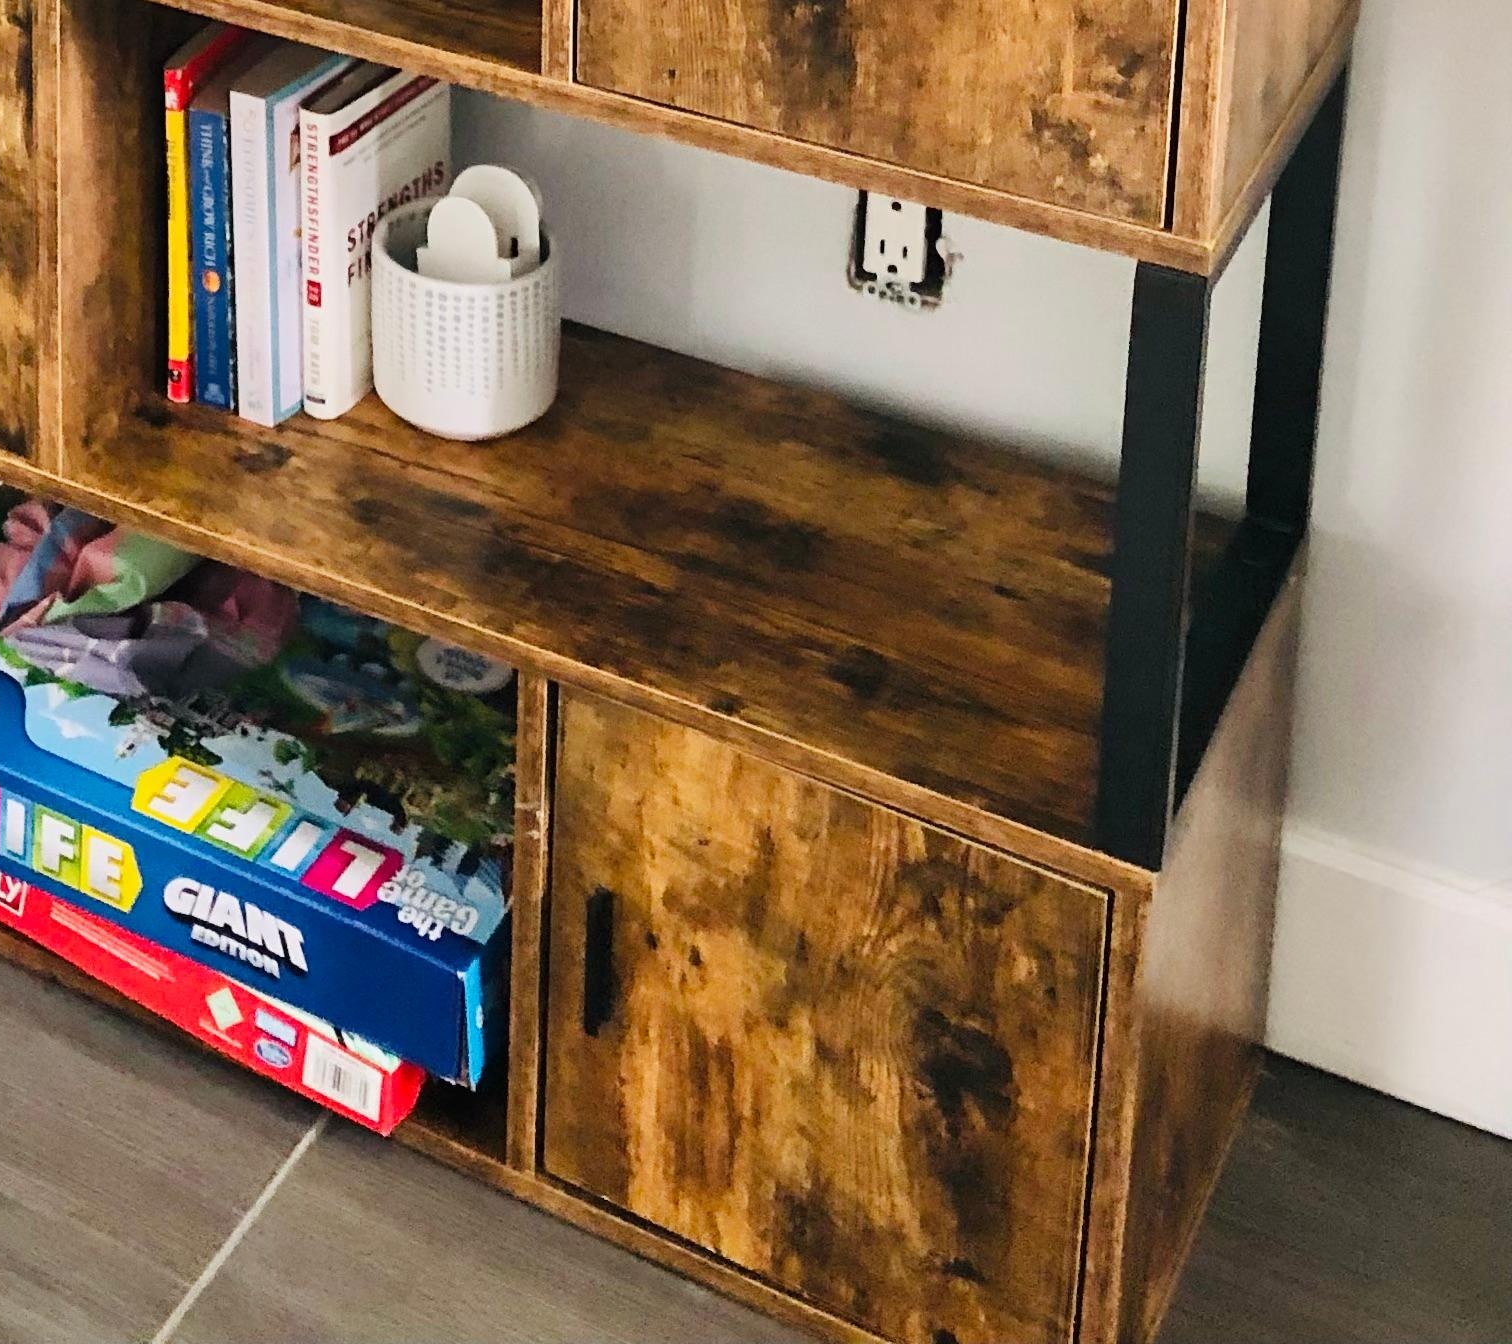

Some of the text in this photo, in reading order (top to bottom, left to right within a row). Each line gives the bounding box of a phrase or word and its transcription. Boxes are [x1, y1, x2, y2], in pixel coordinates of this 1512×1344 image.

[200, 124, 217, 267] THINK GROW RICH
[306, 124, 321, 276] STRENGTHSFINDER
[146, 763, 387, 900] LIFE
[163, 875, 309, 974] GIANT
[190, 922, 282, 980] EDITION
[376, 880, 479, 936] Game
[397, 904, 446, 943] the
